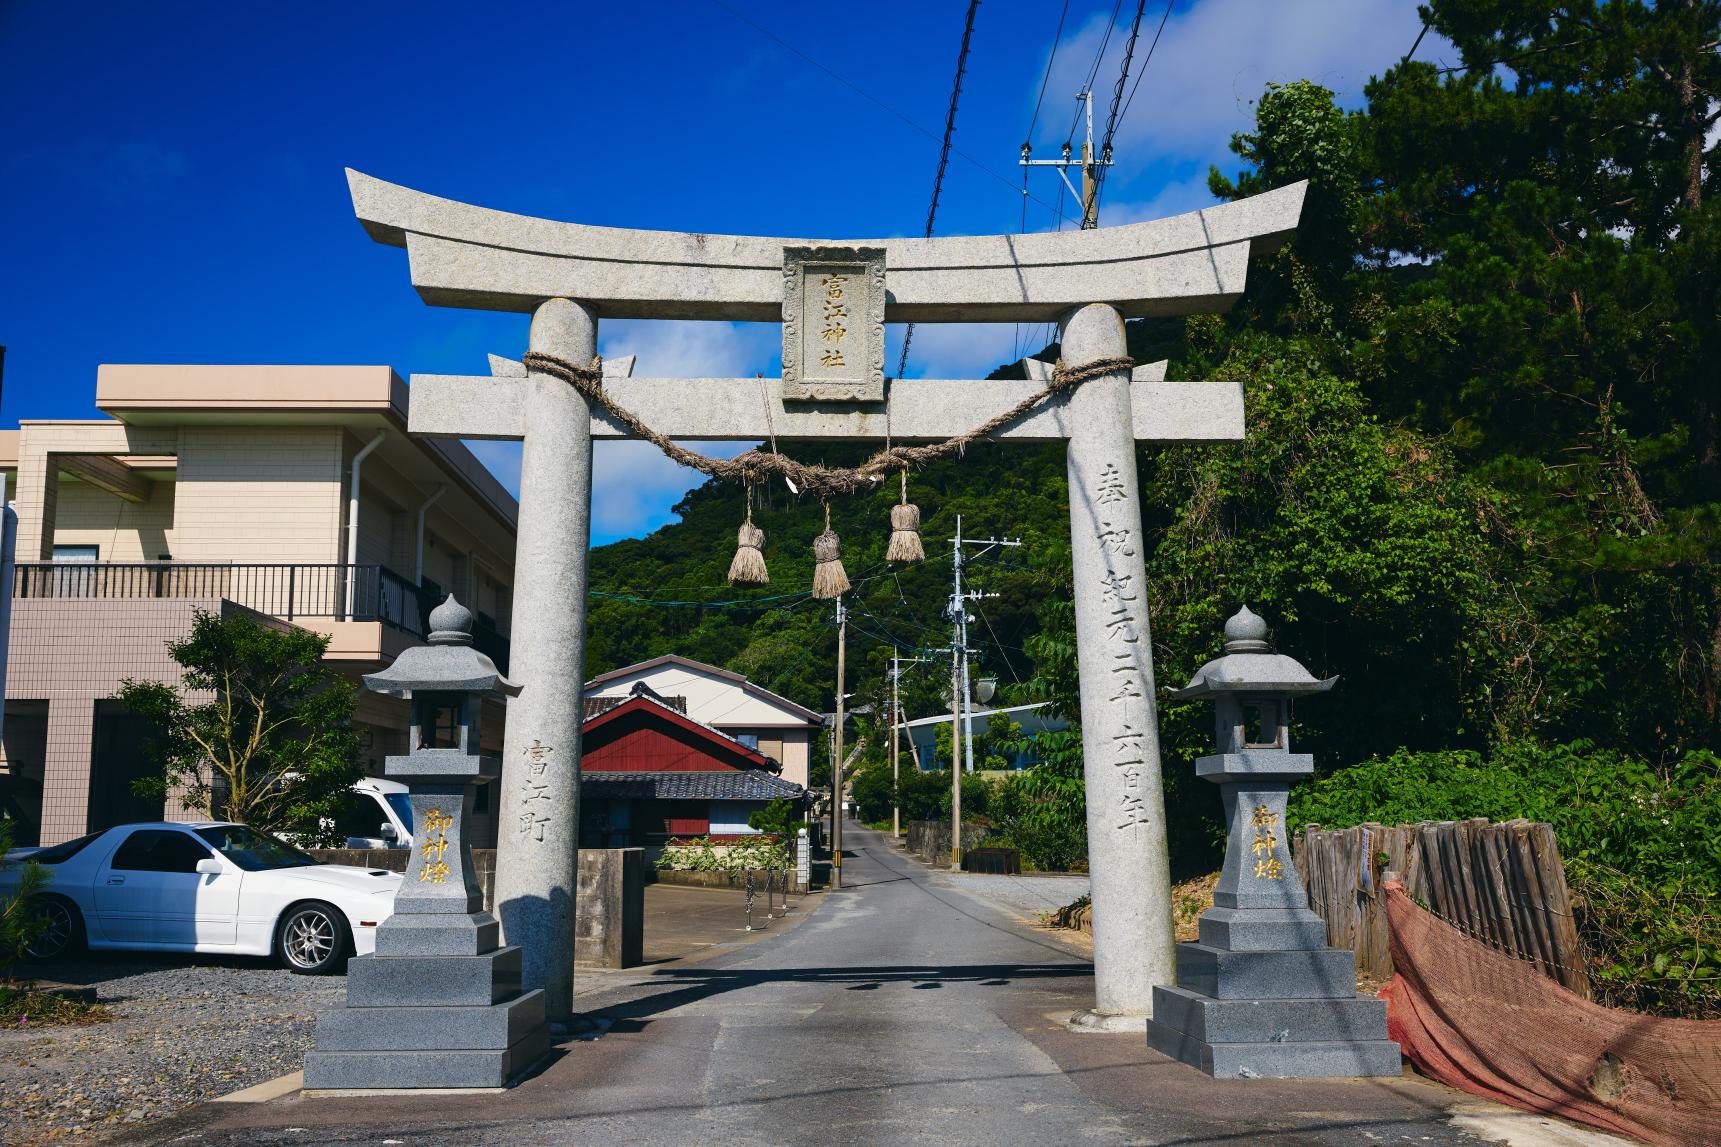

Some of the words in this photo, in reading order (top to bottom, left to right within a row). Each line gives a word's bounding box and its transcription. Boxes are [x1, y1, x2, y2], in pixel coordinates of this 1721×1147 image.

[821, 273, 848, 368] 富江神社
[1094, 463, 1149, 843] 奉祝紀元二千六百年
[520, 739, 554, 842] 富江町
